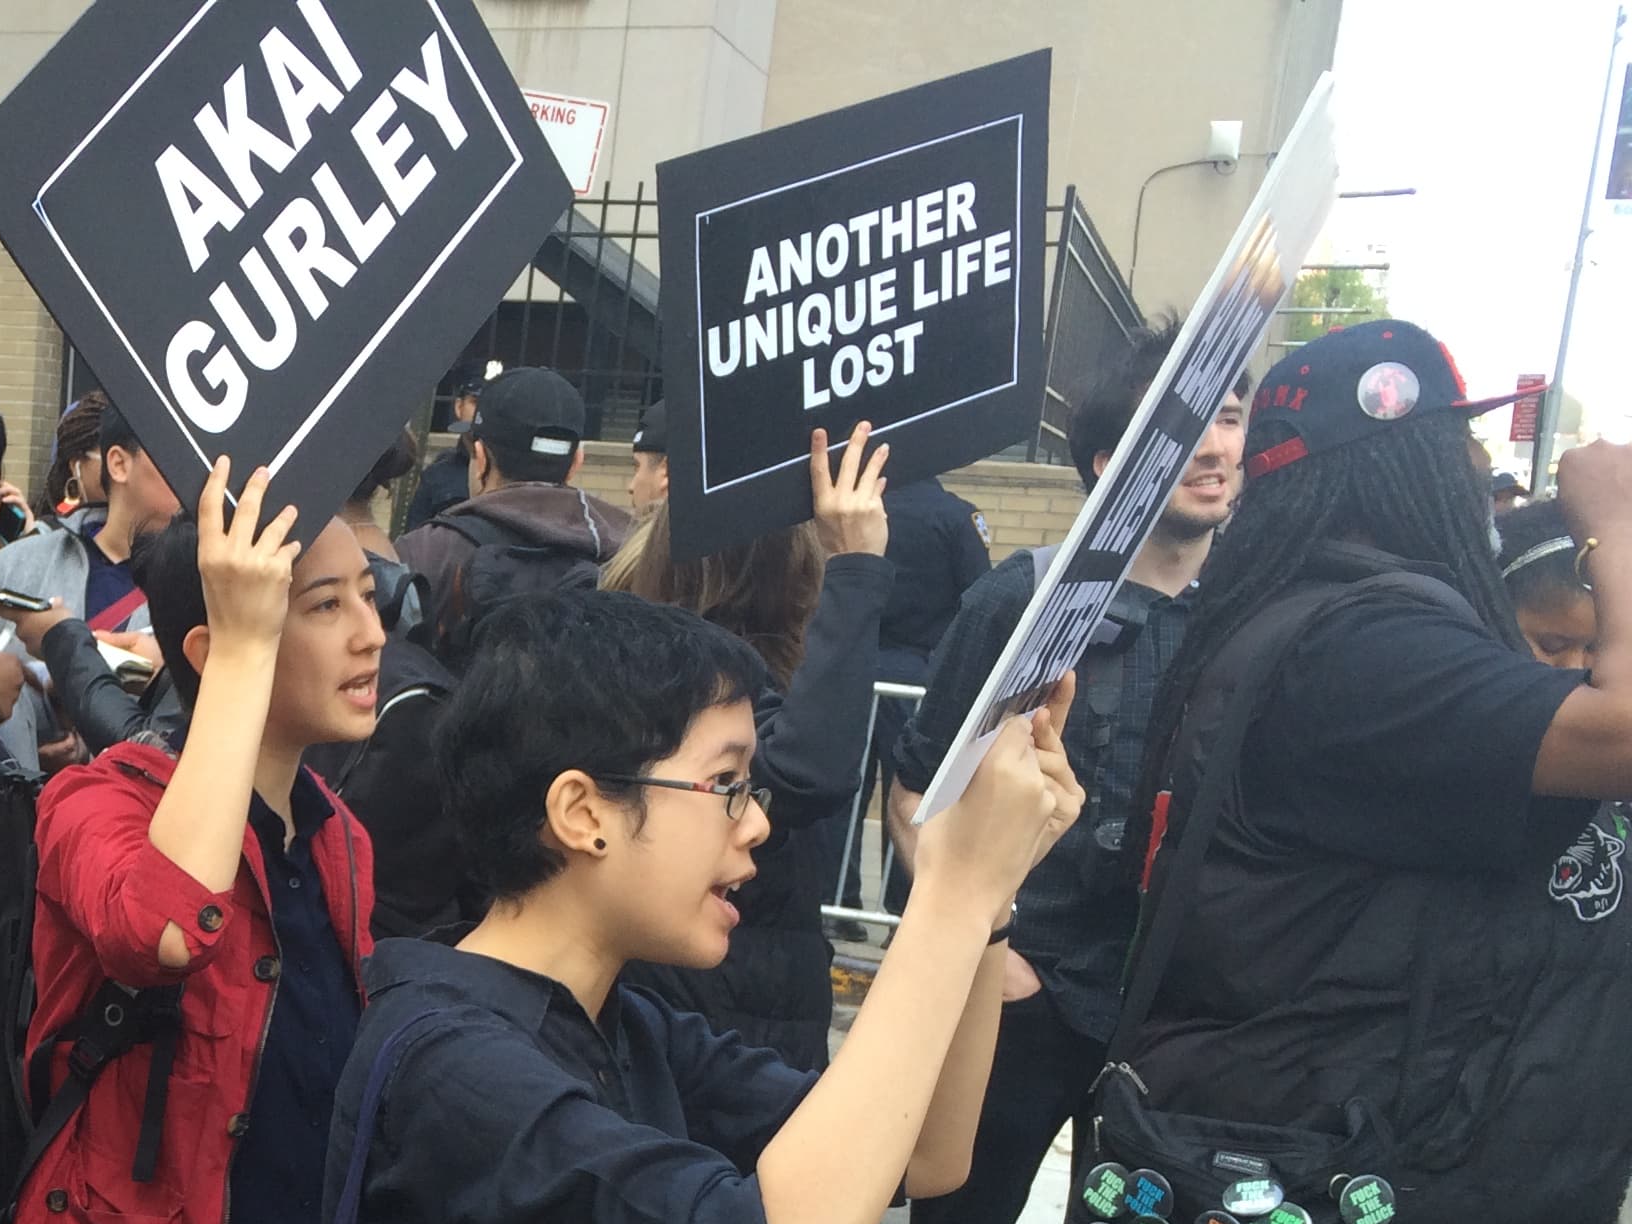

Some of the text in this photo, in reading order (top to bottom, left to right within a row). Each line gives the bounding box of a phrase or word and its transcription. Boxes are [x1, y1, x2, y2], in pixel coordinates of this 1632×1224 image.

[155, 0, 363, 273] AKAI
[166, 32, 468, 434] GURLEY
[707, 230, 1011, 378] UNIQUE LIFE
[743, 180, 978, 305] ANOTHER
[802, 321, 924, 411] LOST
[1174, 264, 1264, 420] BLACK
[1088, 427, 1184, 555] LIVES
